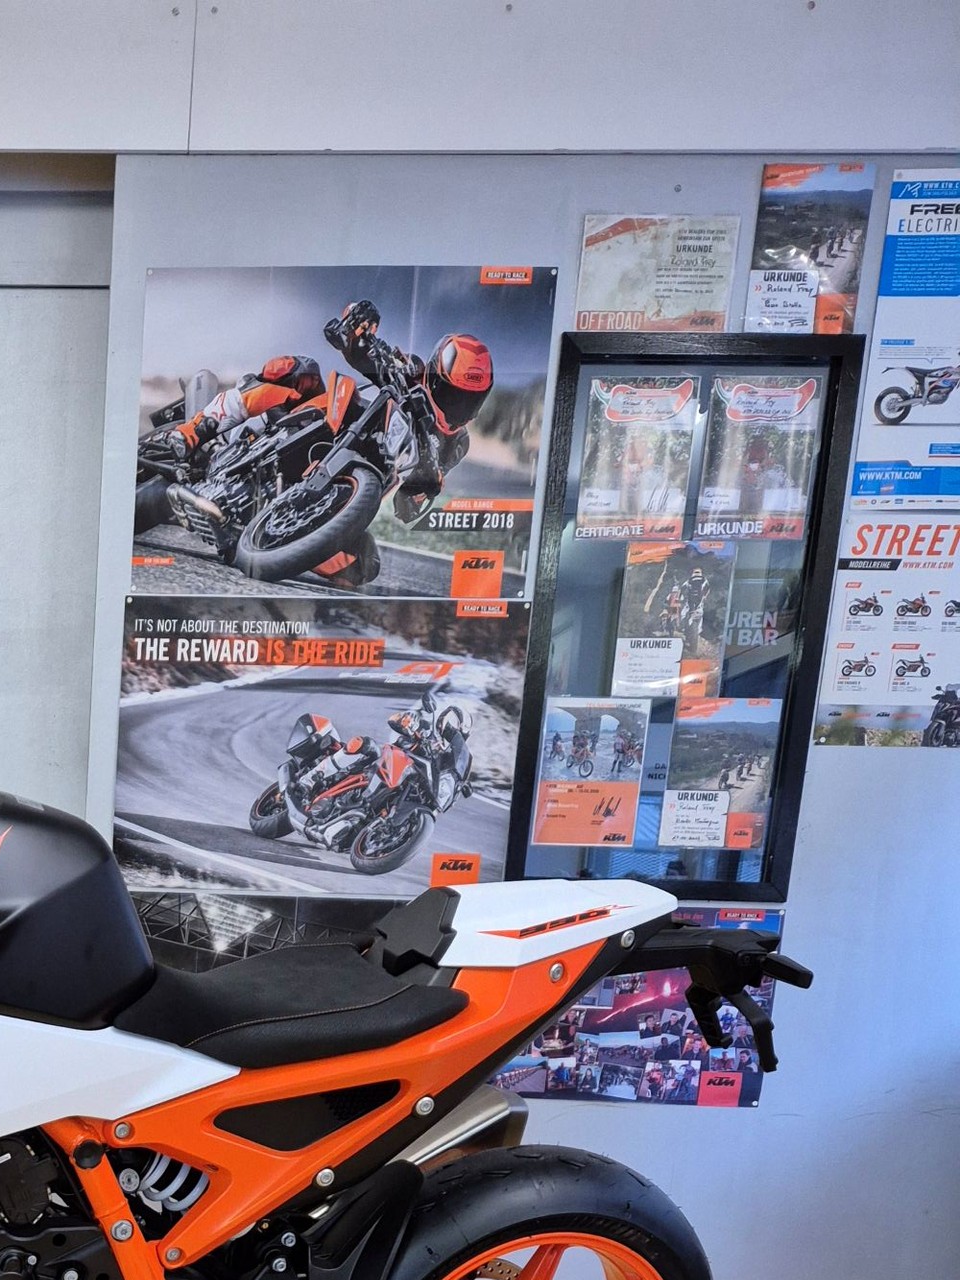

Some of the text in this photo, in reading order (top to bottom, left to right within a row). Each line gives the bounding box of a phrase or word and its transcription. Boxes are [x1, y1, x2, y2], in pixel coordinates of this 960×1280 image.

[676, 244, 713, 253] URKUNDE
[763, 272, 808, 282] URKUNDE
[579, 311, 641, 330] OFFROAD
[859, 471, 922, 480] WWW.KTM.COM
[451, 500, 471, 509] MODEL
[428, 512, 515, 529] STREET 2018
[575, 525, 644, 538] CERTIFICATE
[697, 520, 764, 536] URKUNDE
[851, 523, 960, 556] STREET
[461, 557, 496, 569] KTM
[848, 560, 955, 569] MODELLREIHE WWW.KTM.COM
[134, 618, 310, 634] IT'S NOT ABOUT THE DESTINATION
[630, 640, 672, 649] URKUNDE
[134, 637, 383, 666] THE REWARD IS THE RIDE
[677, 792, 720, 802] URKUNDE
[603, 833, 626, 842] KTM
[439, 859, 474, 871] KTM
[706, 1076, 736, 1087] KTM
